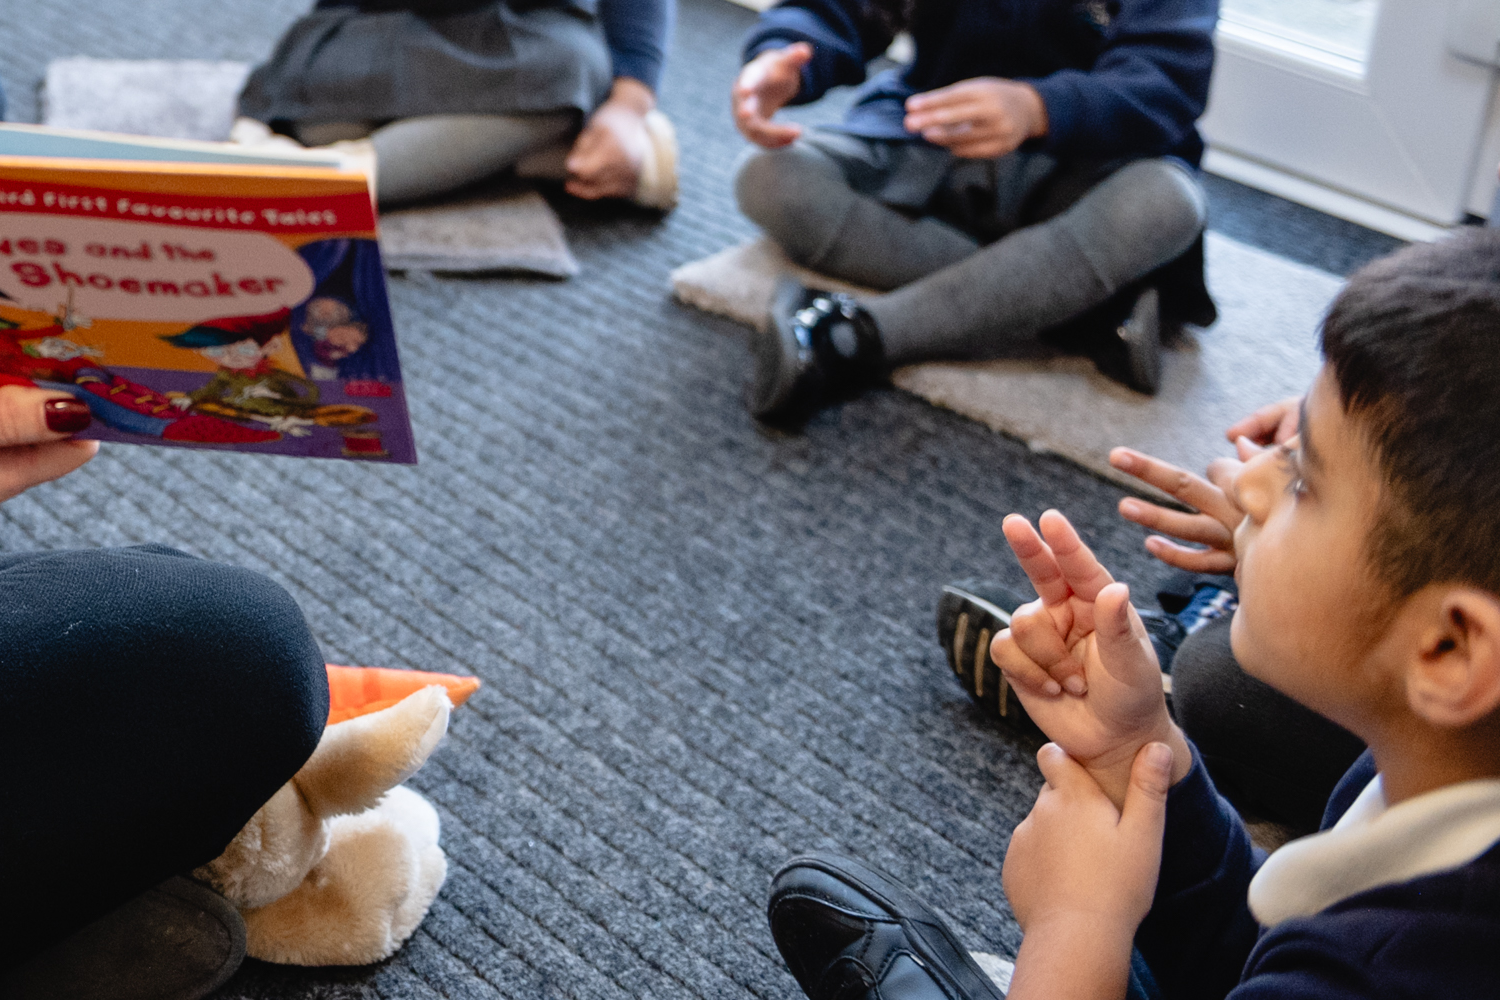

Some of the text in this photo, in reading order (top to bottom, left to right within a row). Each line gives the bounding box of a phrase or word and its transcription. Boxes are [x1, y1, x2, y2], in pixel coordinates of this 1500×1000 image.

[43, 190, 108, 213] First
[116, 197, 256, 225] Favourite
[261, 207, 338, 227] Tales
[84, 240, 153, 261] and
[160, 241, 216, 262] the
[9, 260, 286, 297] Shoemaker
